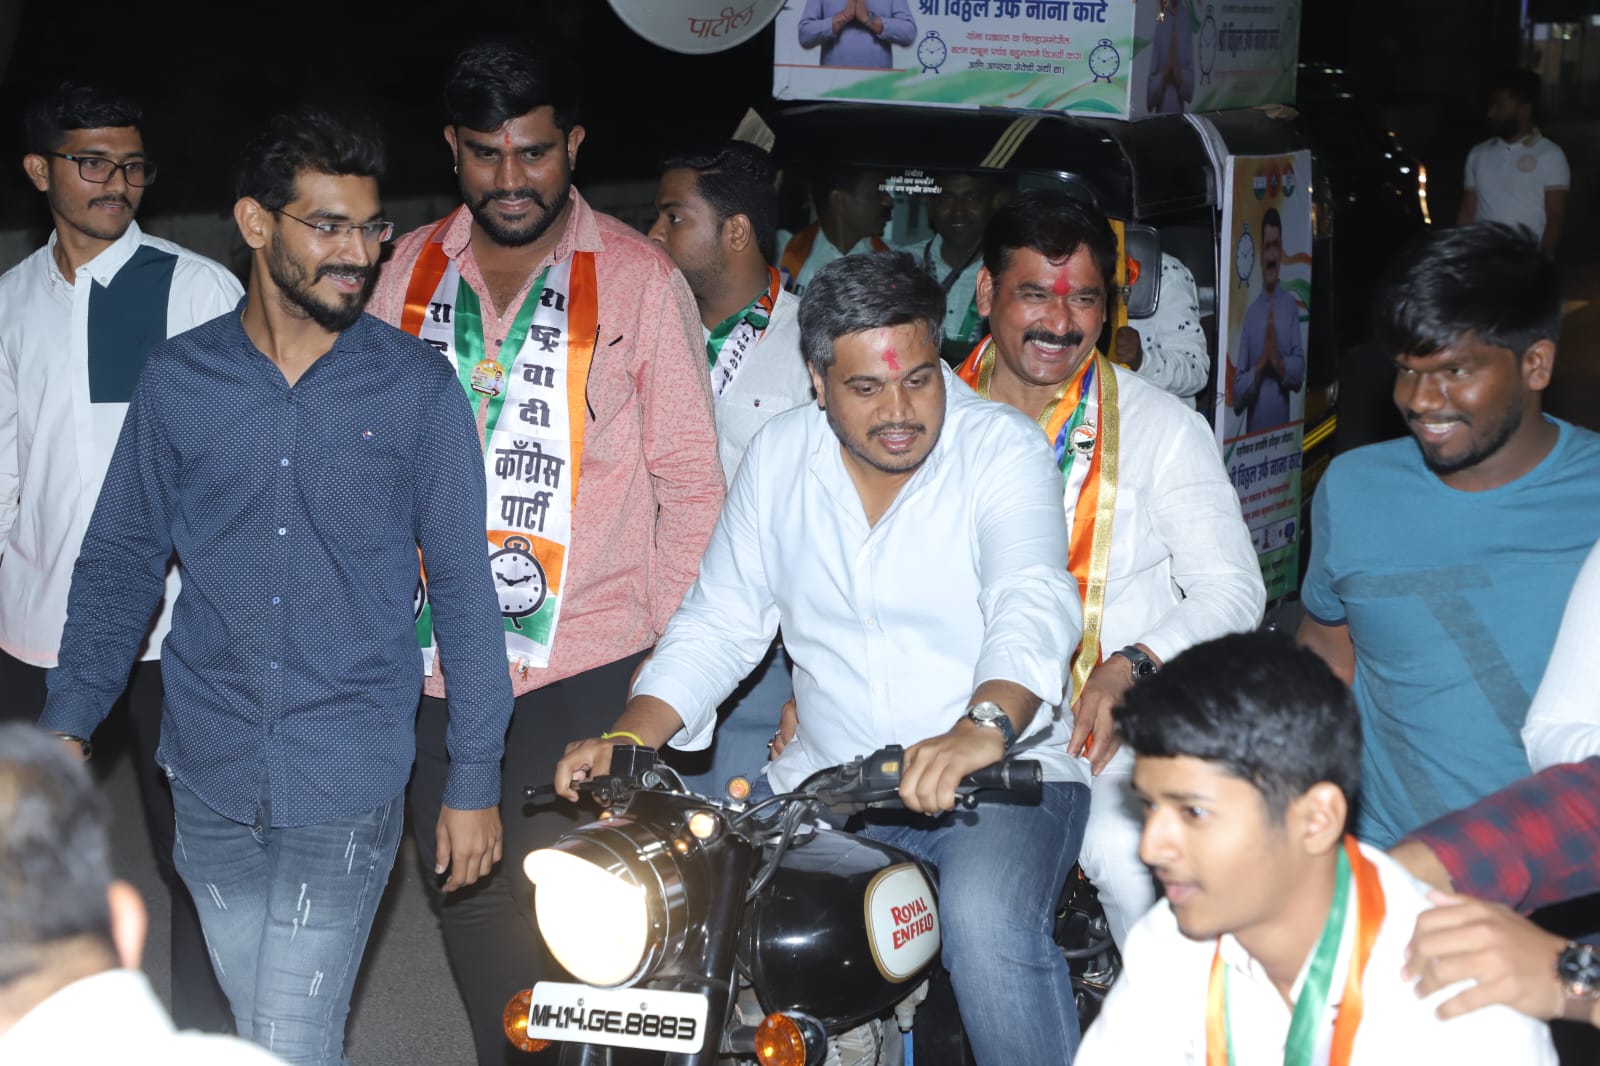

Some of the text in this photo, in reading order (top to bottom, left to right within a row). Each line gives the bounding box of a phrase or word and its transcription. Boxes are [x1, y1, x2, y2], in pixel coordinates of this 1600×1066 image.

[688, 6, 753, 38] पाटील
[1026, 0, 1069, 21] नाना
[501, 491, 553, 532] पार्टी
[890, 896, 927, 926] ROYAL
[892, 912, 934, 950] ENFIELD
